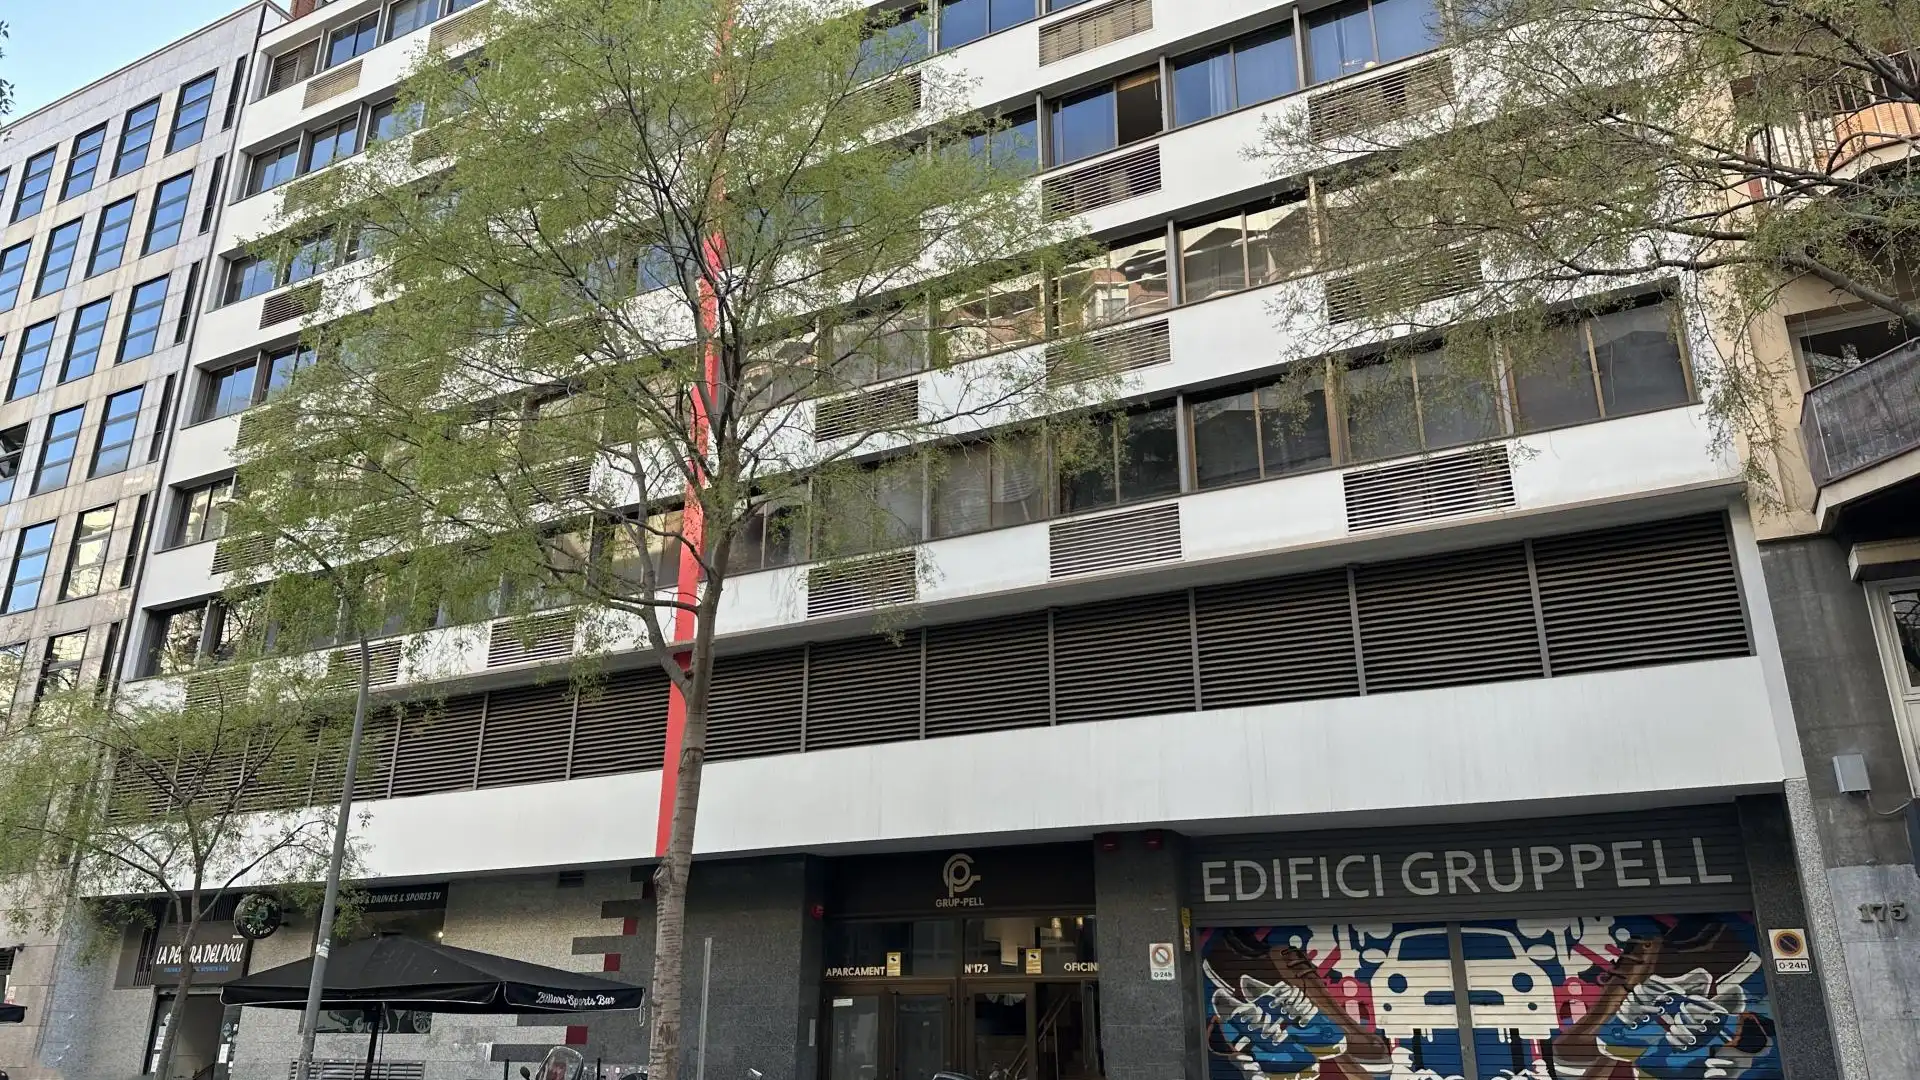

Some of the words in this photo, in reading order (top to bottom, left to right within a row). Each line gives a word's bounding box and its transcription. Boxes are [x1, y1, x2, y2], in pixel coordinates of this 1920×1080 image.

[1202, 854, 1385, 902] EDIFICI
[1401, 837, 1733, 896] GRUPPELL
[371, 894, 399, 904] DRINKS
[405, 892, 432, 901] SPORTS
[432, 891, 442, 900] TV
[935, 897, 985, 908] GRUP-PELL
[1857, 902, 1908, 922] 175
[156, 946, 168, 965] LA
[168, 944, 203, 964] PERA
[203, 943, 222, 963] DEL
[220, 943, 244, 962] POOL
[825, 966, 885, 977] APARCAMENT
[1063, 961, 1100, 972] OFICIN
[1779, 962, 1807, 970] 0-24h
[536, 992, 567, 1004] Billars
[566, 995, 596, 1008] Sports
[596, 994, 616, 1006] Bar
